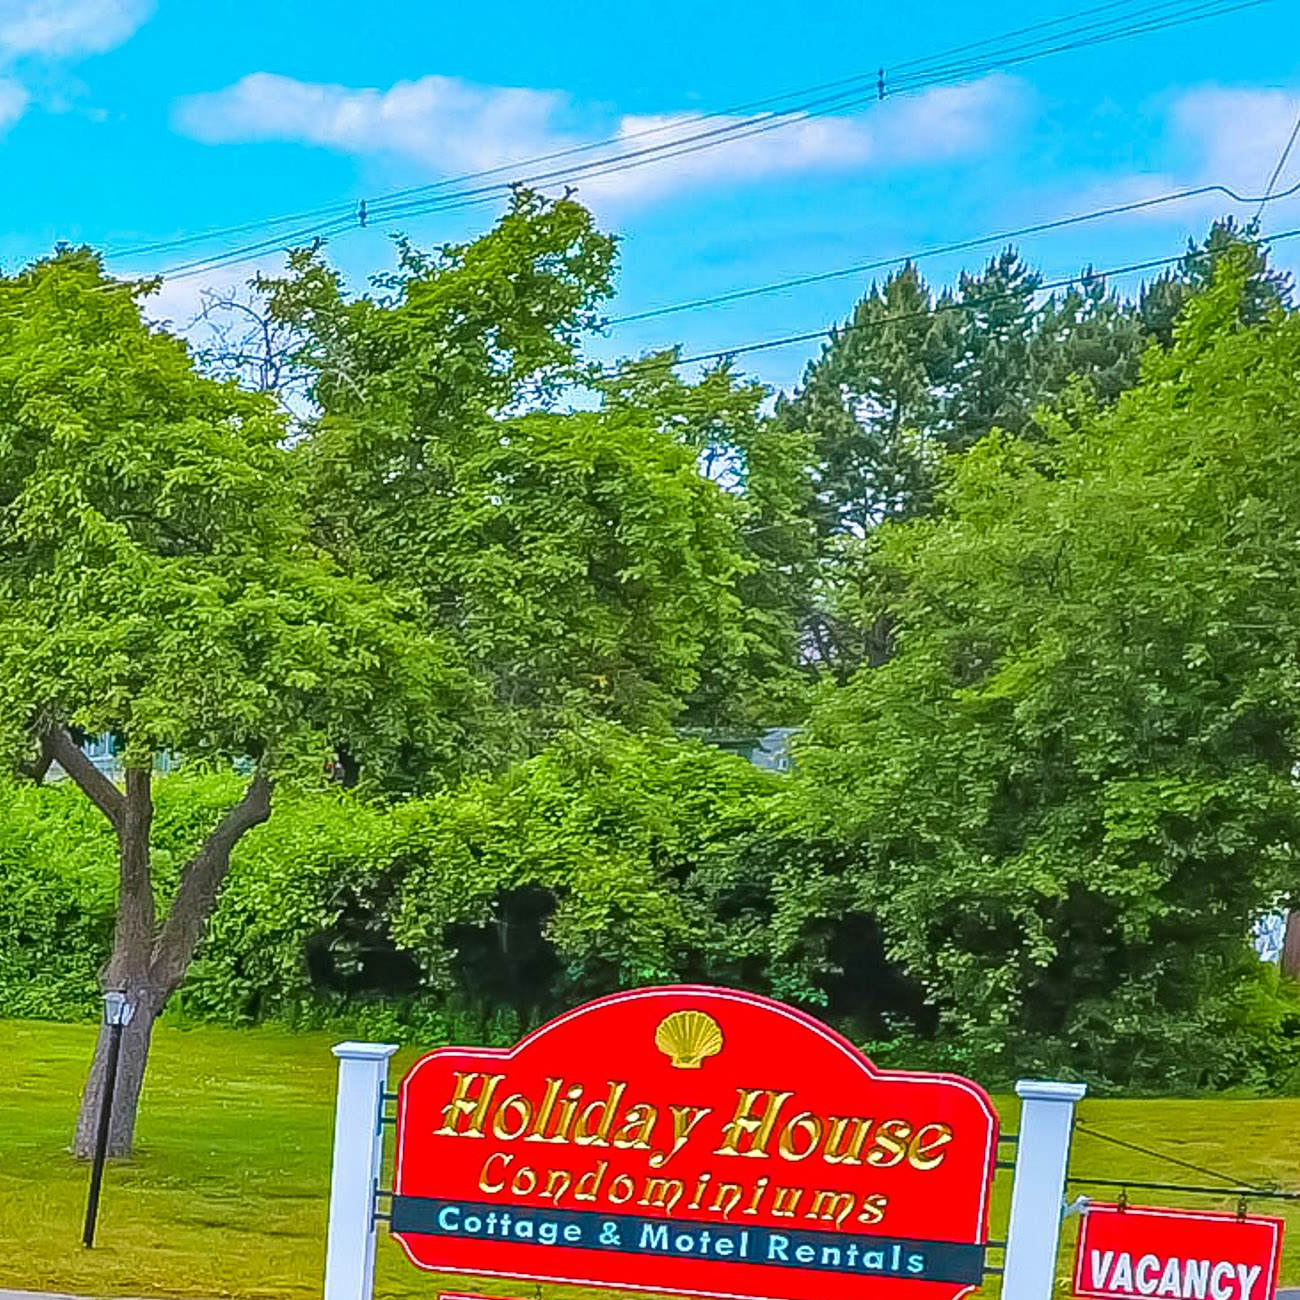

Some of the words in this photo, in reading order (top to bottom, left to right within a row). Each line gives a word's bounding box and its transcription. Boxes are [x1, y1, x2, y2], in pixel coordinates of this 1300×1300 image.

[432, 1071, 712, 1168] Holiday
[712, 1088, 952, 1170] House
[478, 1152, 888, 1231] Condominiums
[437, 1206, 582, 1245] Cottage
[599, 1221, 622, 1246] &
[638, 1223, 748, 1257] Motel
[767, 1234, 925, 1272] Rentals
